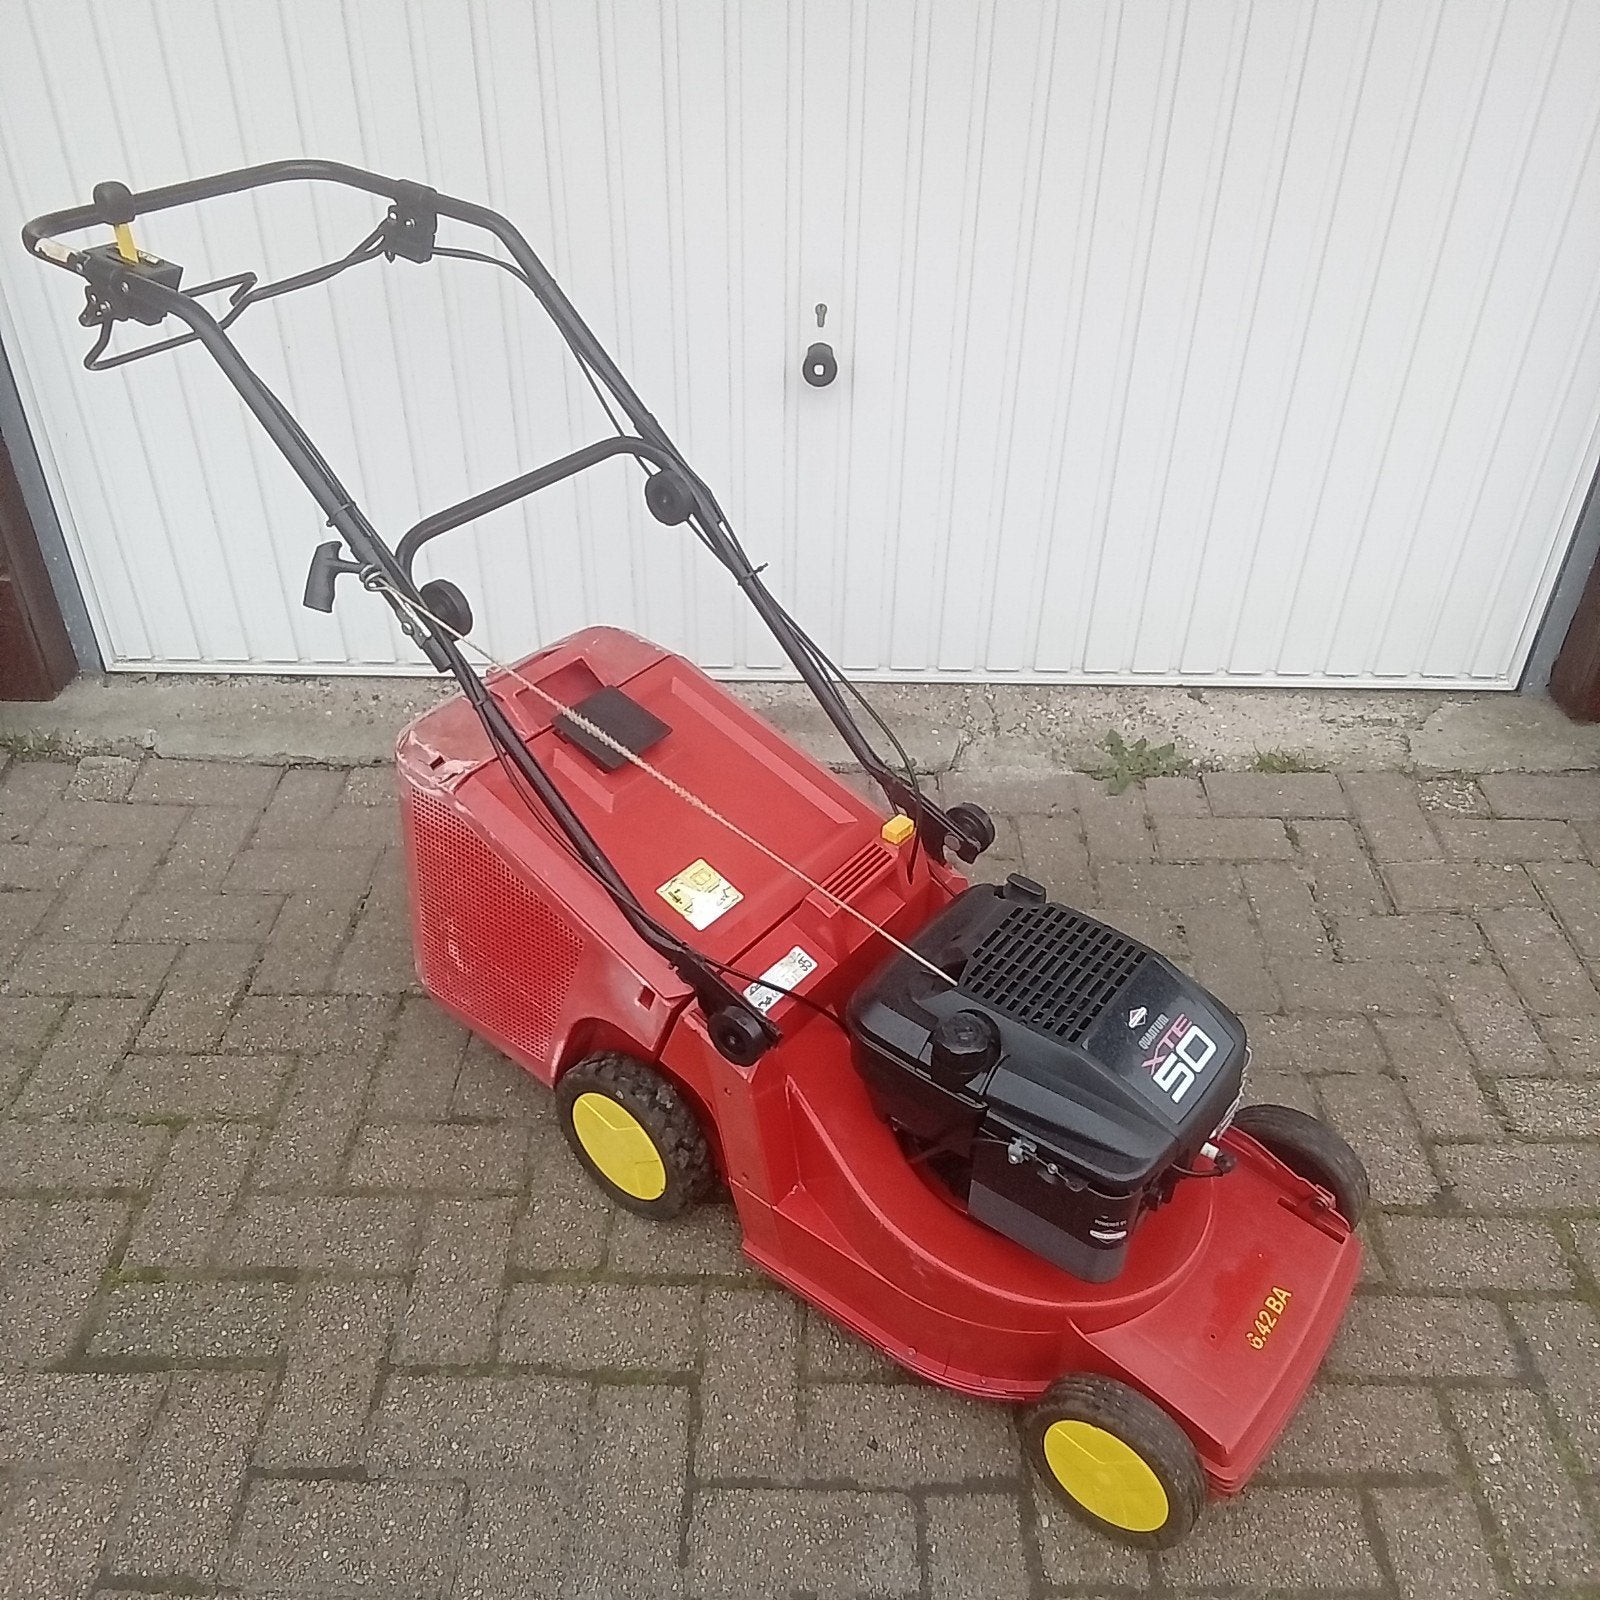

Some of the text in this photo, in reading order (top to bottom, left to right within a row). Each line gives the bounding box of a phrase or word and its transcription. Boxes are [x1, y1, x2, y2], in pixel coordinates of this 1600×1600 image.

[1138, 1014, 1170, 1050] QUANTUM
[1141, 1013, 1193, 1075] XTE
[1152, 1025, 1217, 1104] 50
[1264, 1286, 1292, 1315] BA
